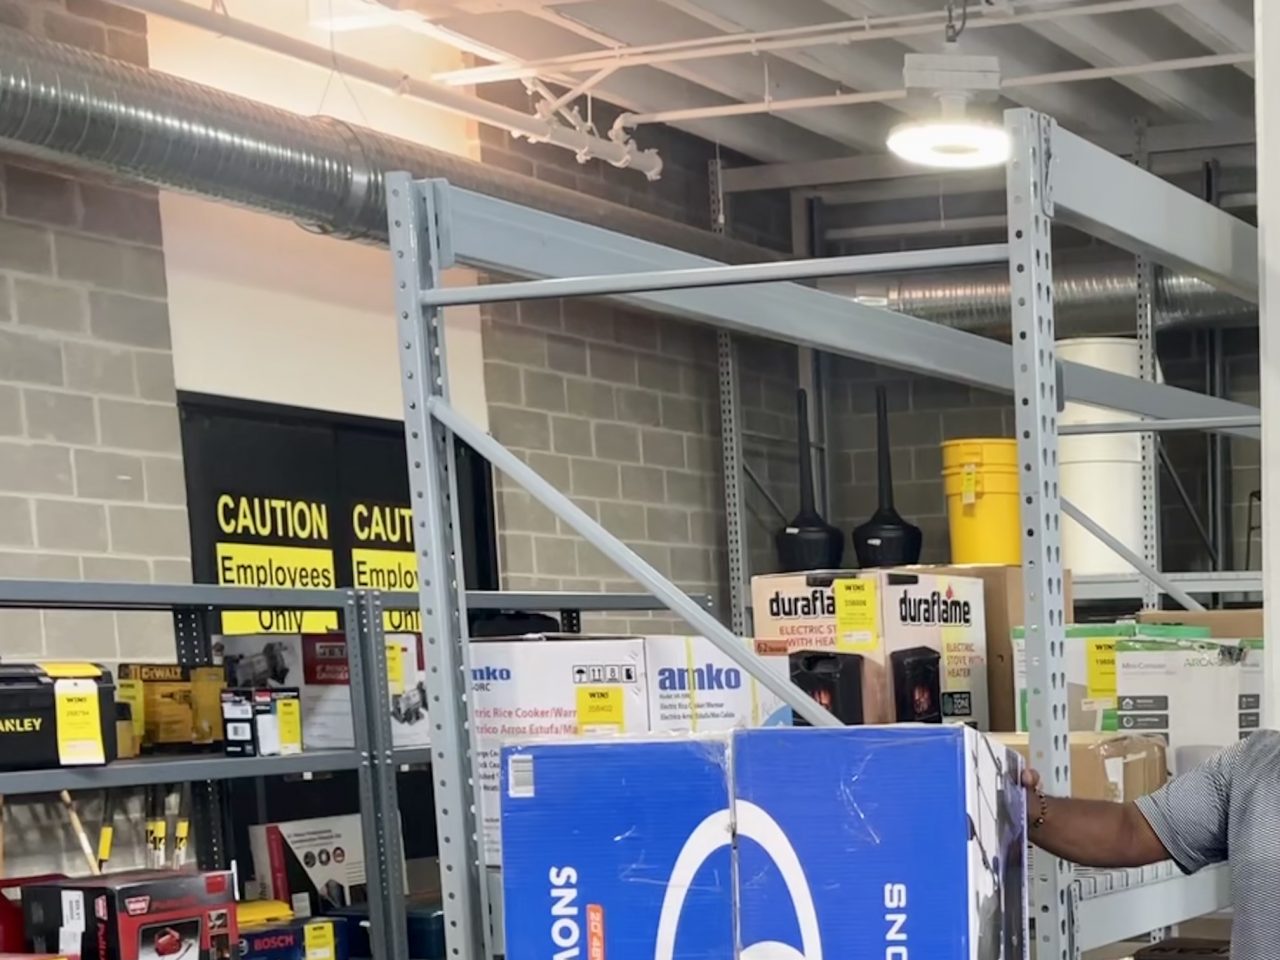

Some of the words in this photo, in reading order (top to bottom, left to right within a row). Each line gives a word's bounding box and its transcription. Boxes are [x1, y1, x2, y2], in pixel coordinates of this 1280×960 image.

[217, 494, 329, 540] CAUTION
[221, 556, 332, 588] Employees
[899, 589, 971, 624] duraflame
[779, 625, 824, 635] ELECTRIC
[658, 663, 741, 691] amko
[493, 707, 513, 718] Rice
[254, 935, 294, 950] BOSCH
